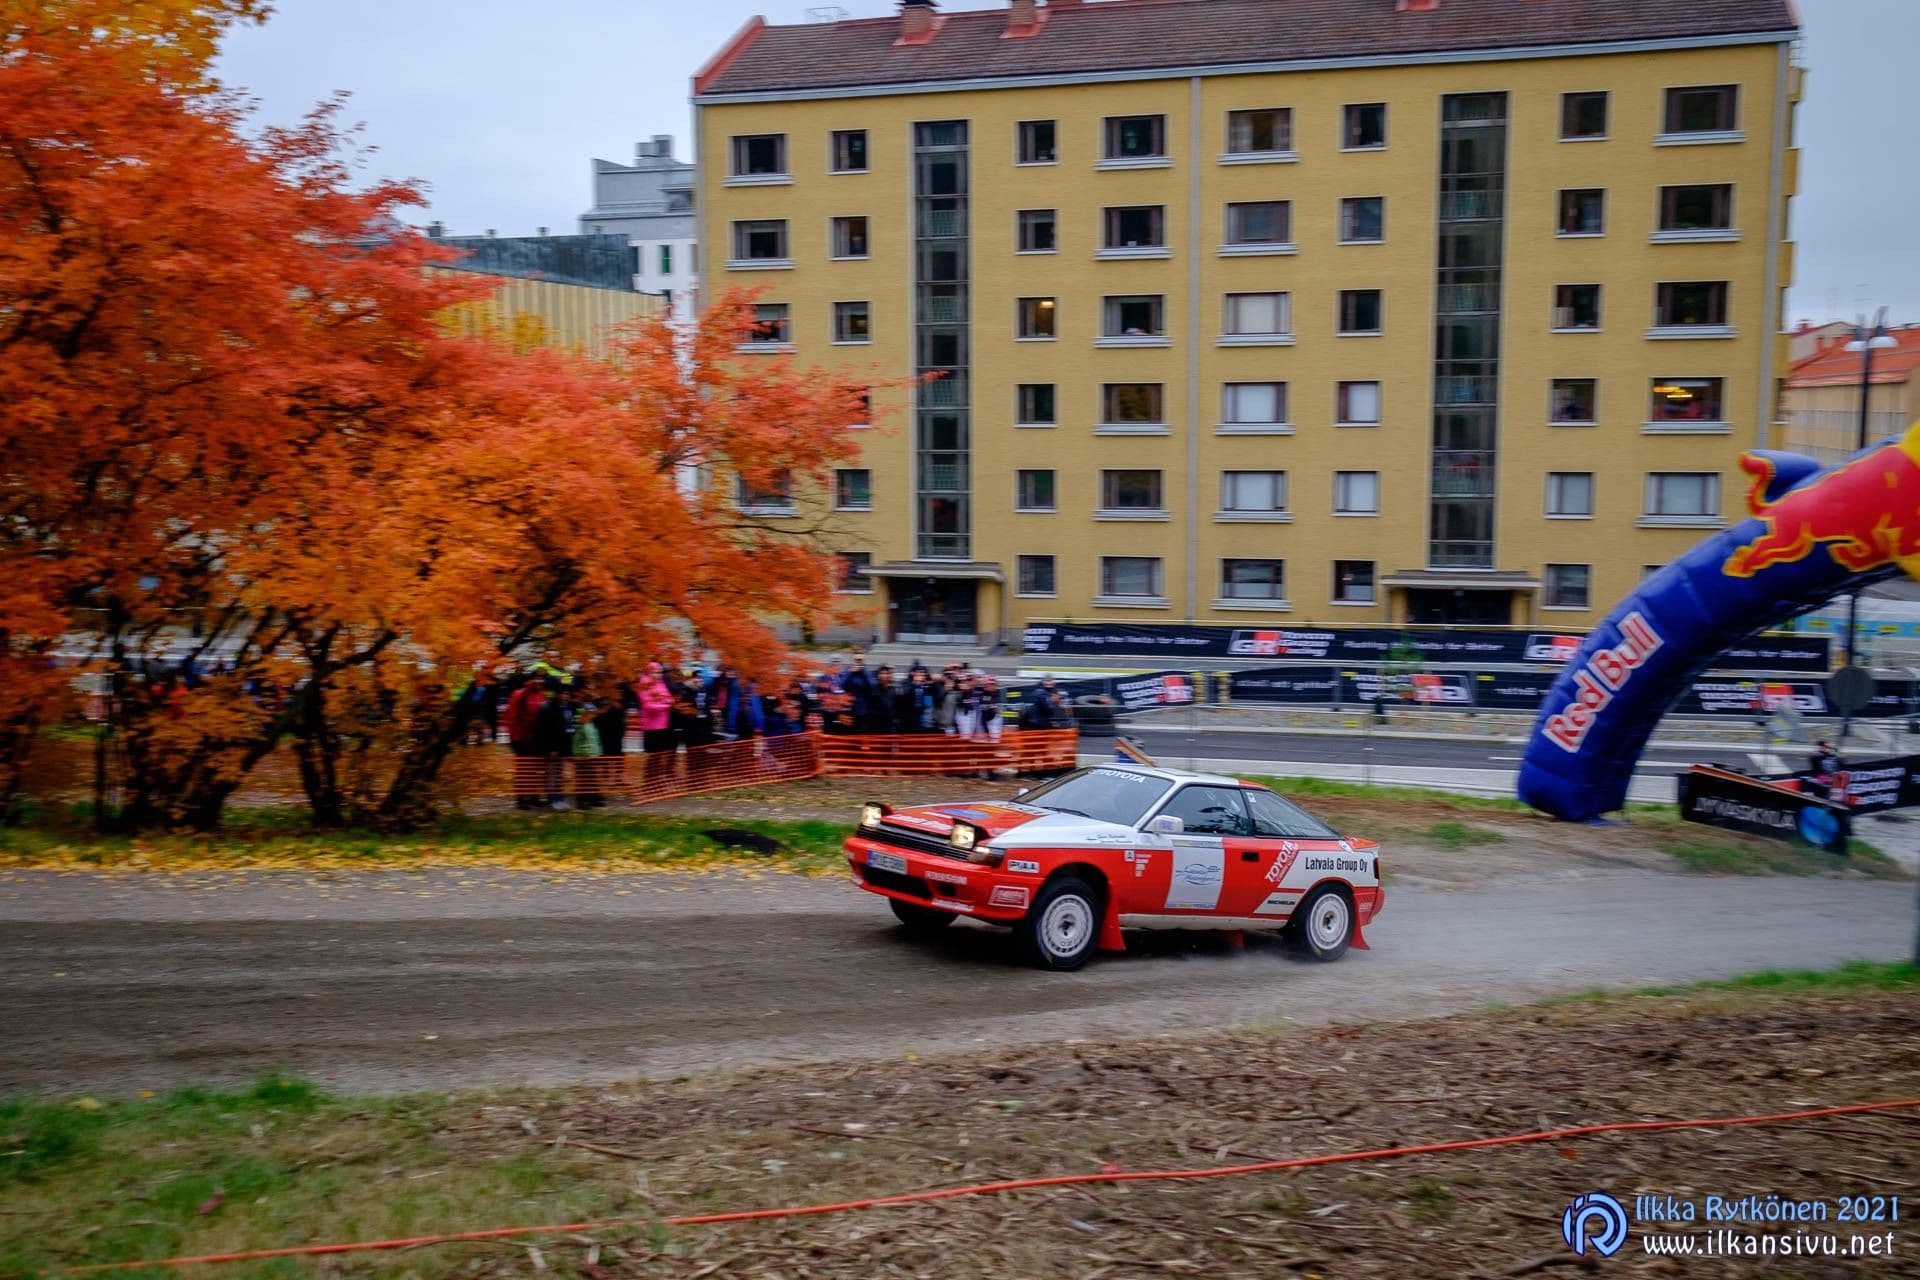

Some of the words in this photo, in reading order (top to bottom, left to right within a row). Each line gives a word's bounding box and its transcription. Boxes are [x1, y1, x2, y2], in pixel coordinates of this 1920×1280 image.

[1542, 669, 1613, 753] Red
[1586, 610, 1665, 691] Bull
[1100, 769, 1147, 784] TOYOTA
[1264, 839, 1296, 882] TOYOTA
[1305, 857, 1334, 871] Latvala
[1336, 858, 1358, 872] Group
[1359, 858, 1368, 872] Oy
